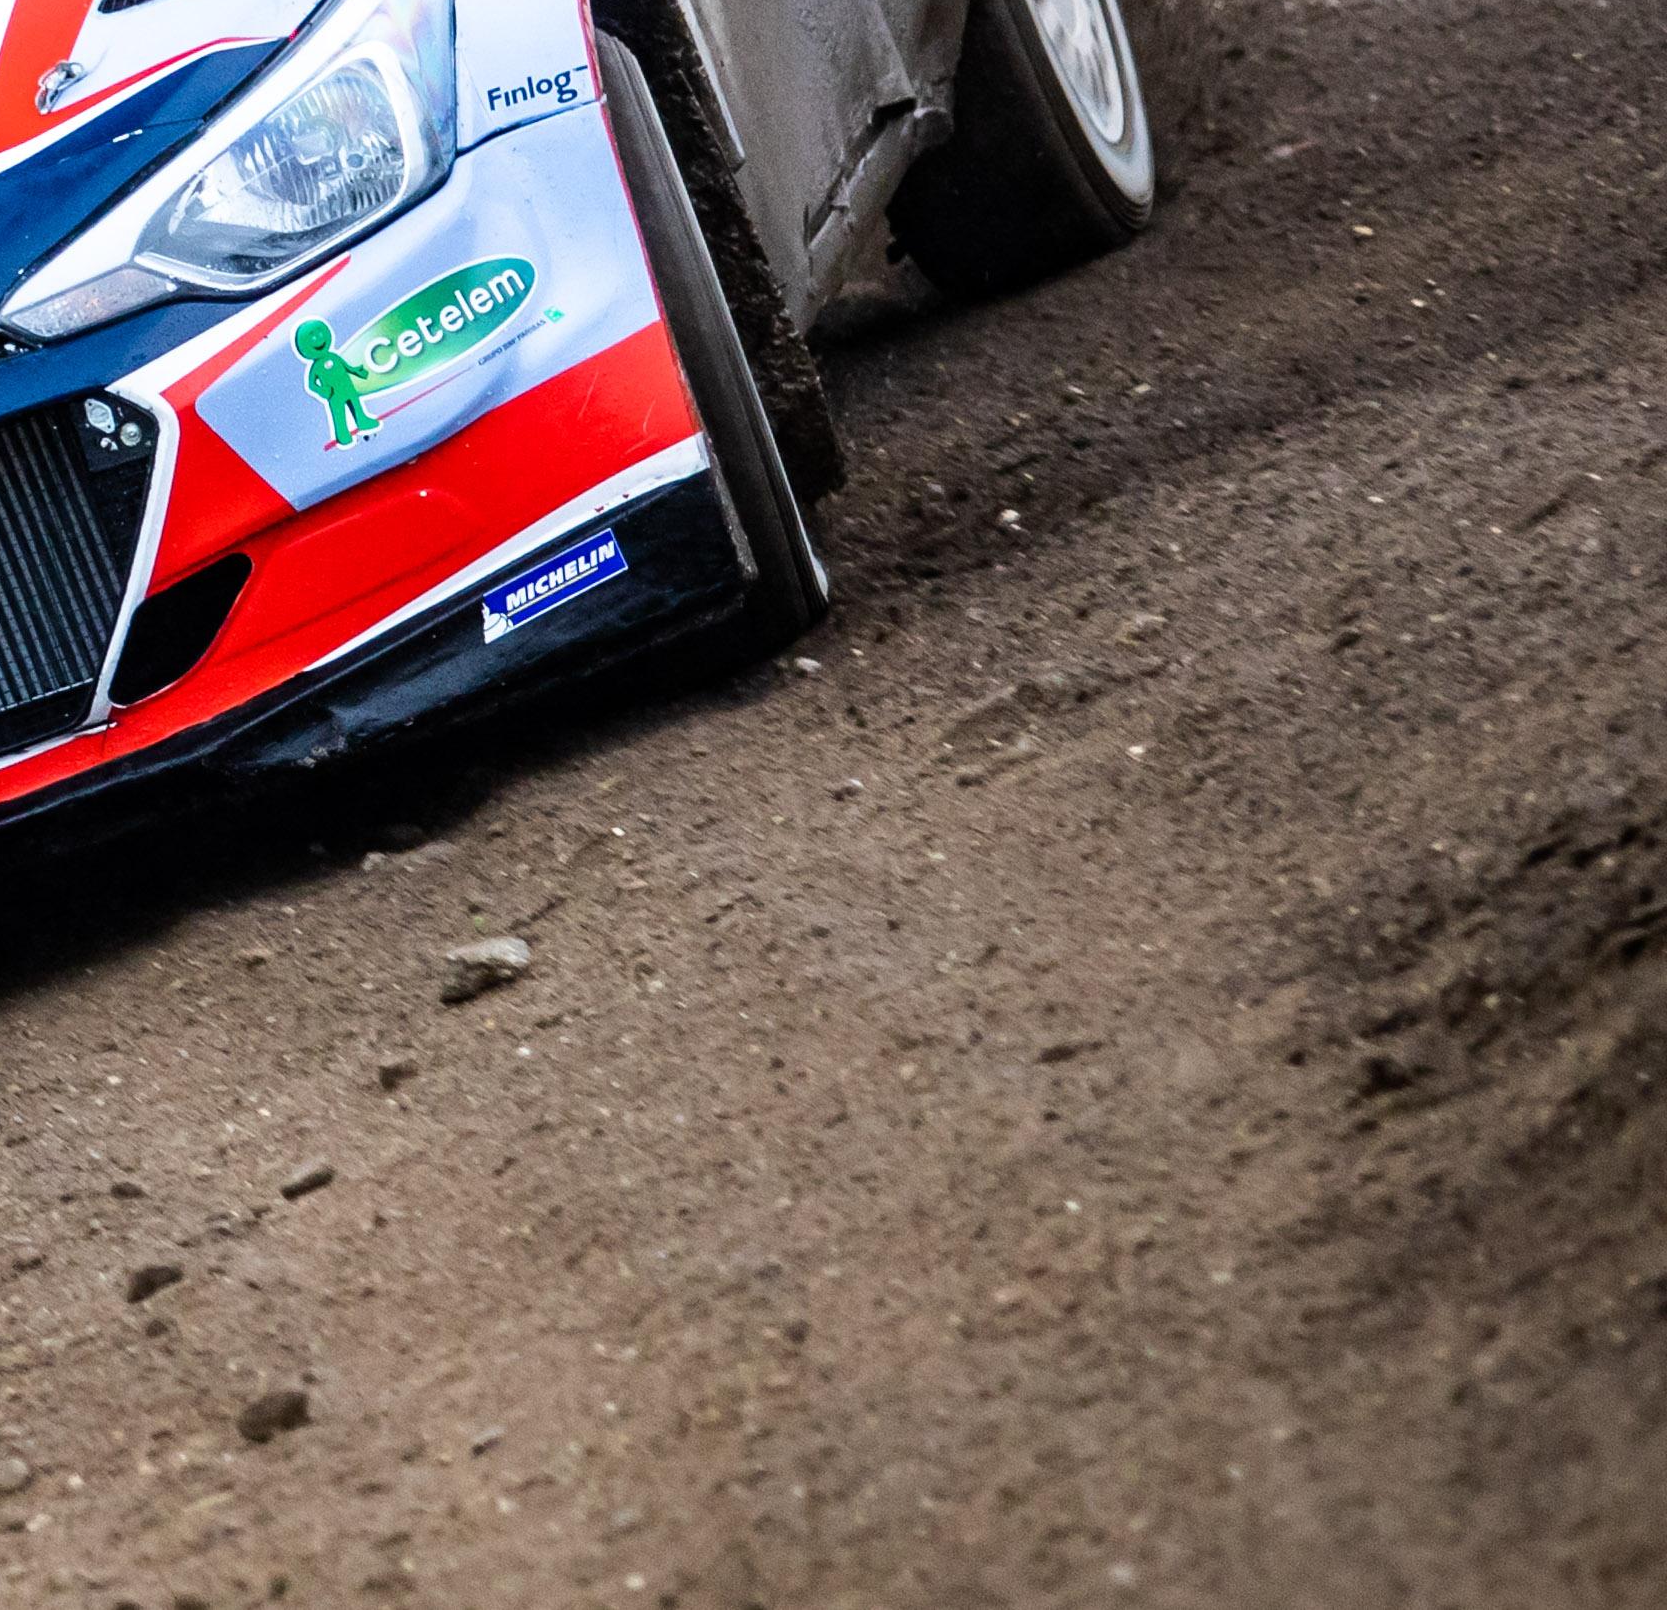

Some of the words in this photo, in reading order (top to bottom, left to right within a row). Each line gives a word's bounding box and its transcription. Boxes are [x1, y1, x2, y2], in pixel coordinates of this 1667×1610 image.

[487, 70, 578, 111] Finlog
[362, 264, 527, 375] Cetelem
[505, 541, 616, 612] MICHELIN
